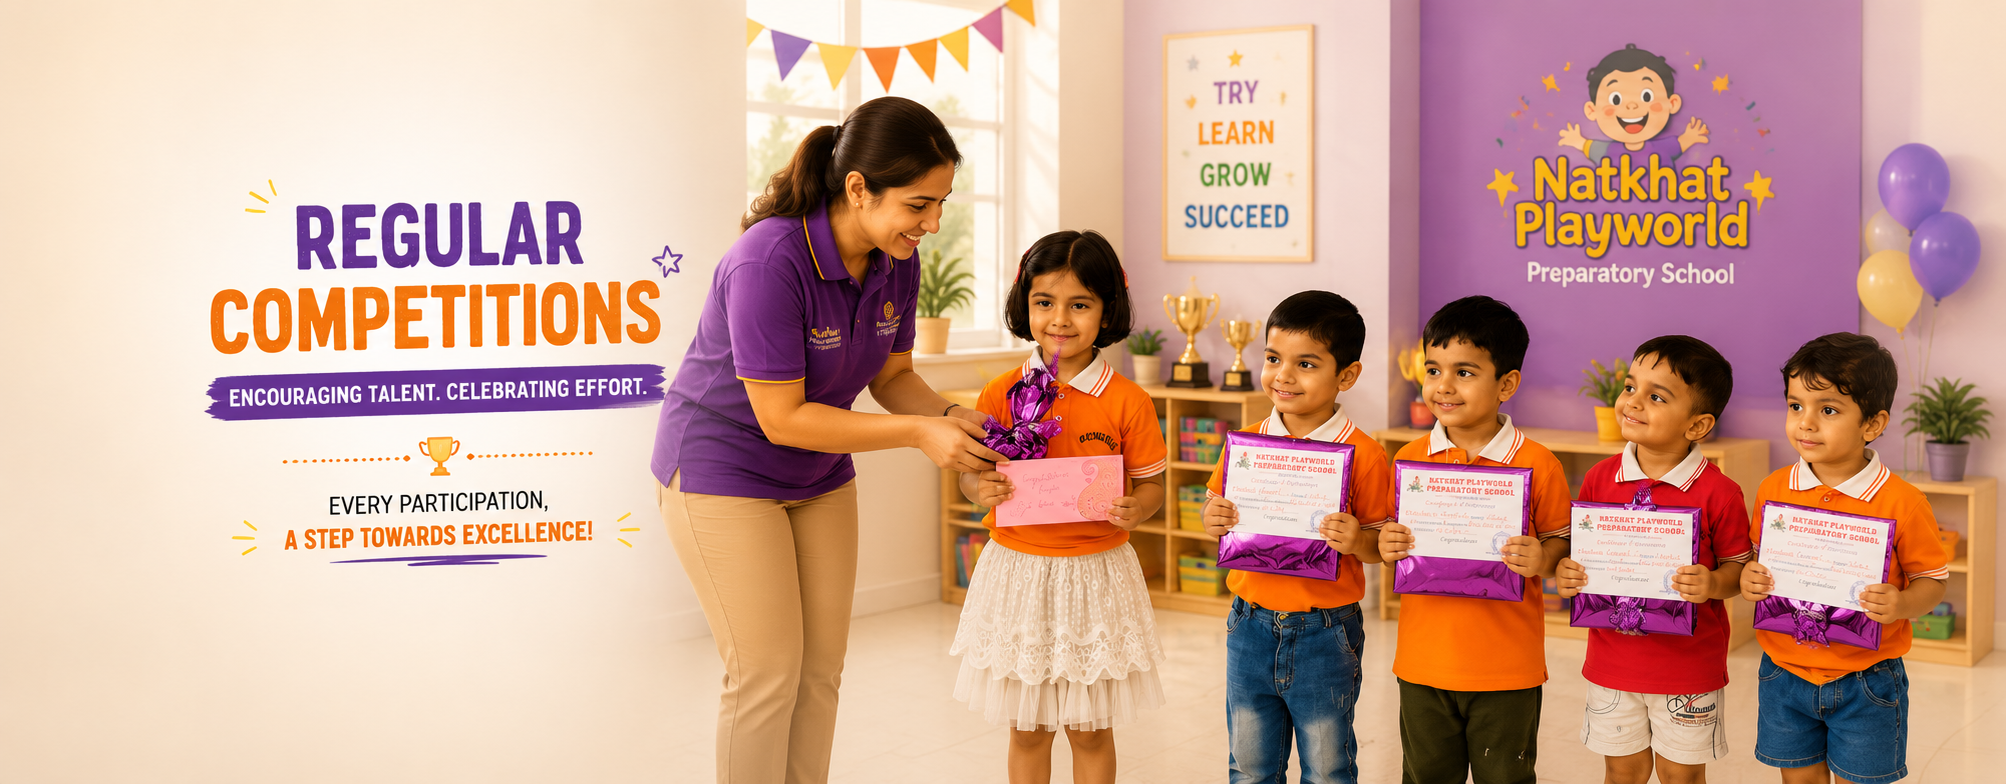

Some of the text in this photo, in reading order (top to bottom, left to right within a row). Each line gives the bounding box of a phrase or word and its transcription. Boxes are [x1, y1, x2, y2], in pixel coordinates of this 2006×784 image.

[1214, 80, 1258, 104] TRY
[1198, 120, 1274, 145] LEARN
[1200, 163, 1271, 187] GROW
[1533, 154, 1730, 202] Natkhat
[1185, 205, 1289, 228] SUCCEED
[1514, 200, 1750, 258] Playworld
[1527, 262, 1735, 288] Preparatory School
